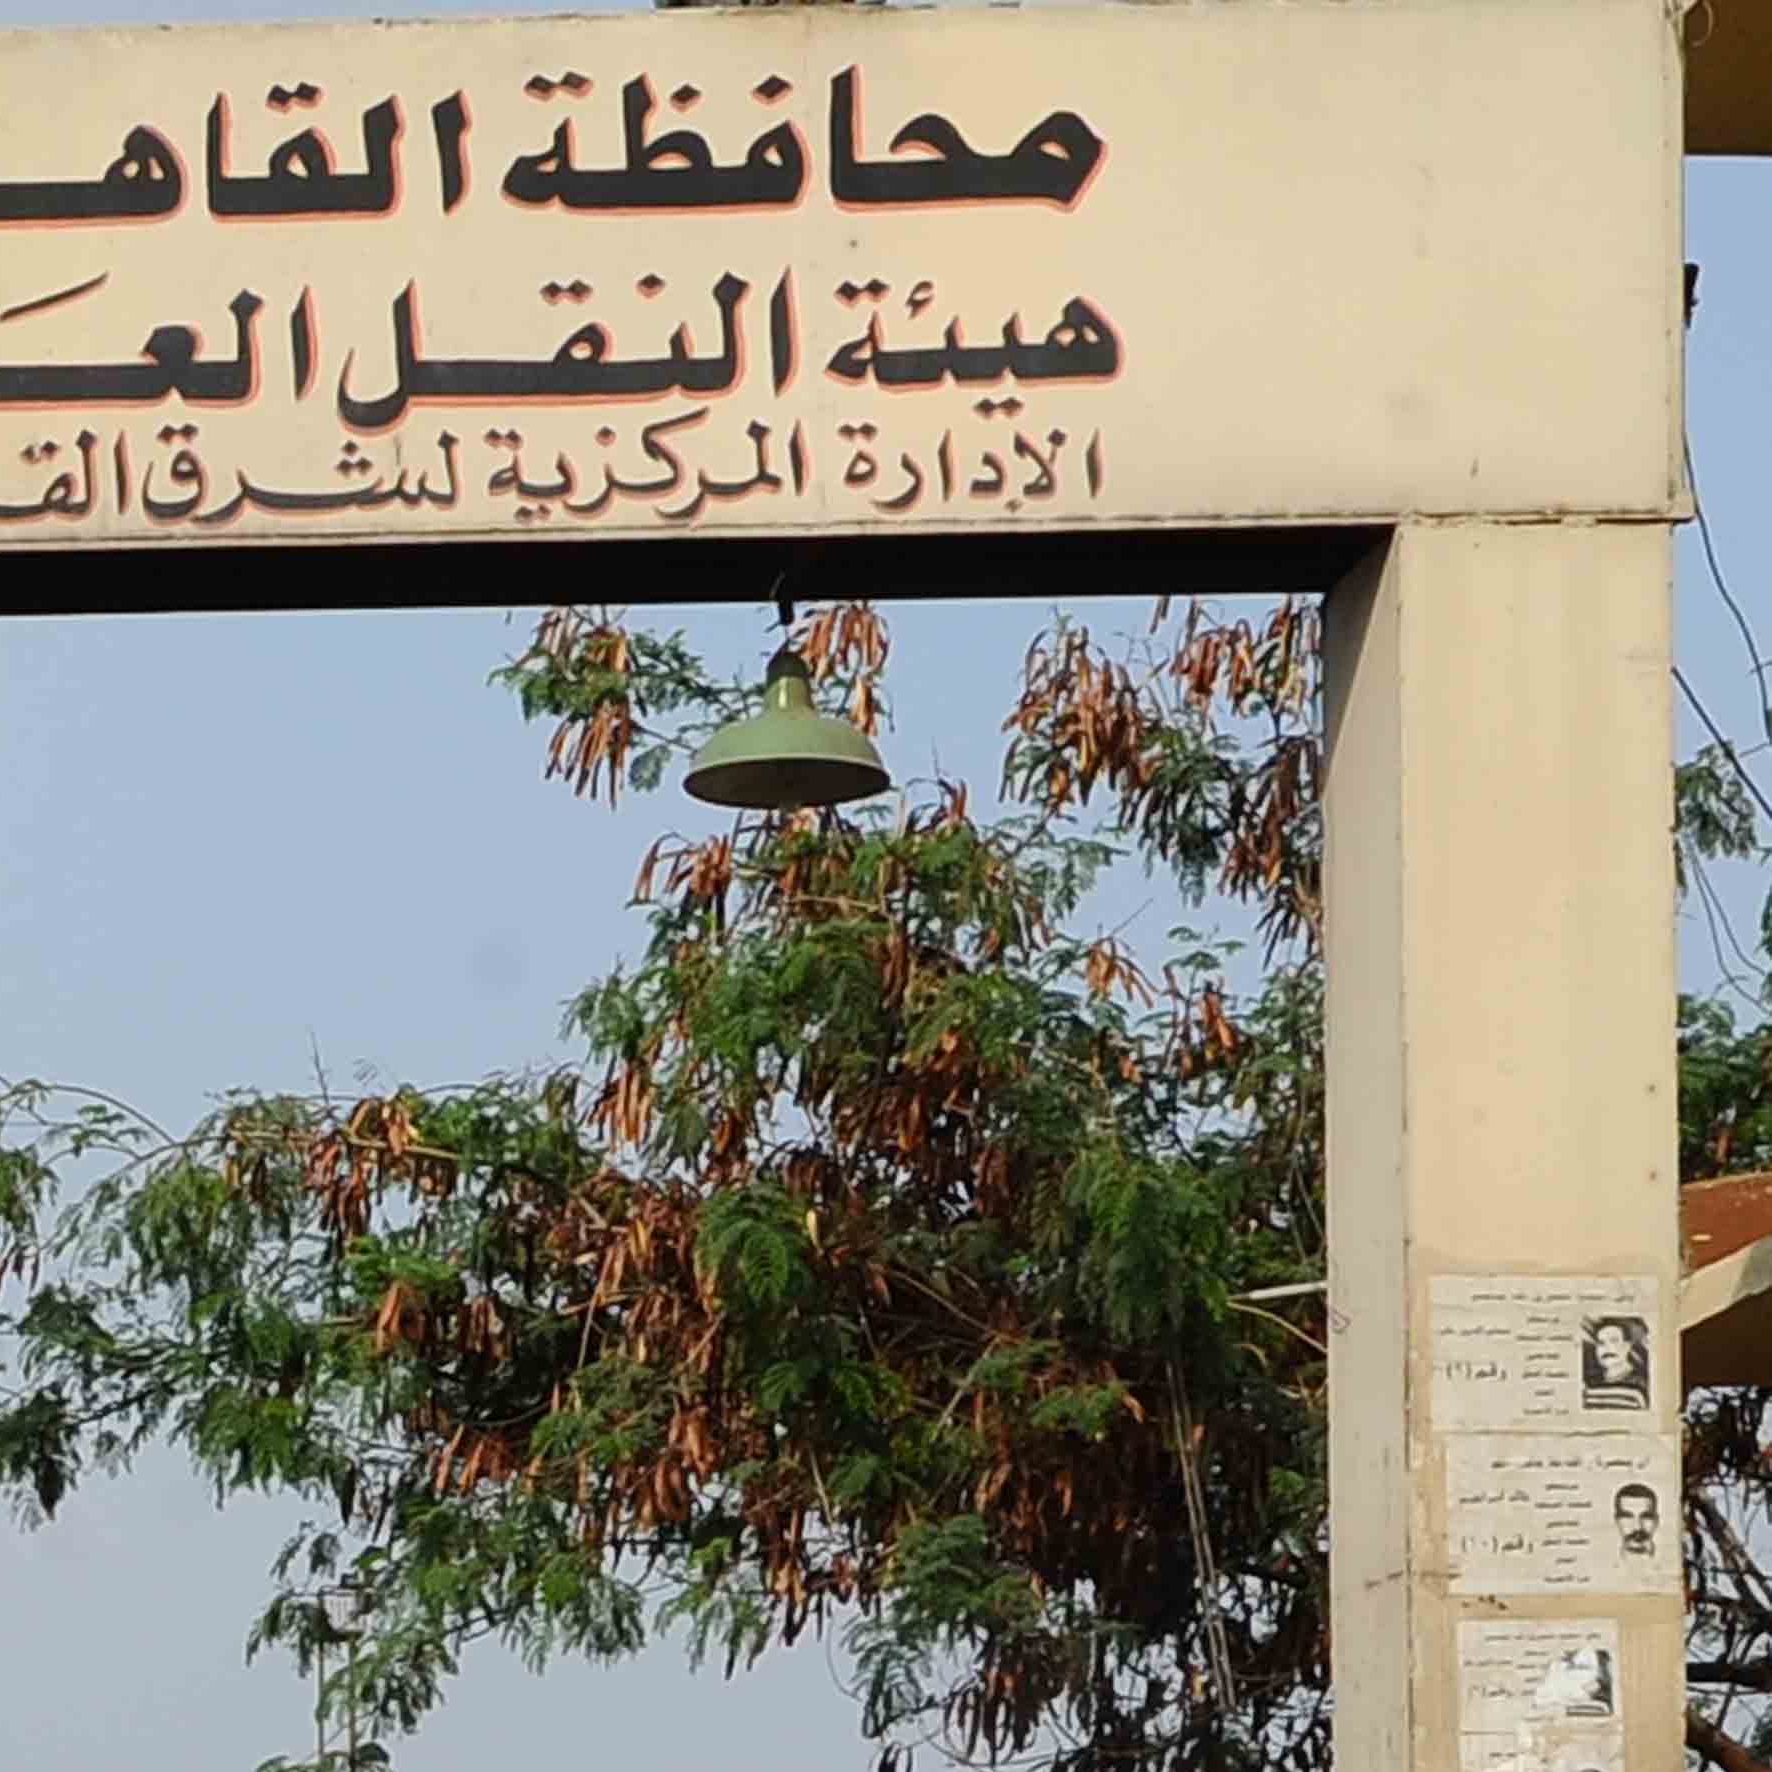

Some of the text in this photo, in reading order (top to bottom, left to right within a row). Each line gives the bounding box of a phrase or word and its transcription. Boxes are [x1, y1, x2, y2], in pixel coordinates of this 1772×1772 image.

[501, 66, 1107, 212] محافظة
[335, 266, 795, 430] النقل
[825, 276, 1121, 416] هيئة
[141, 422, 459, 526] لشرق
[485, 405, 809, 524] المركزية
